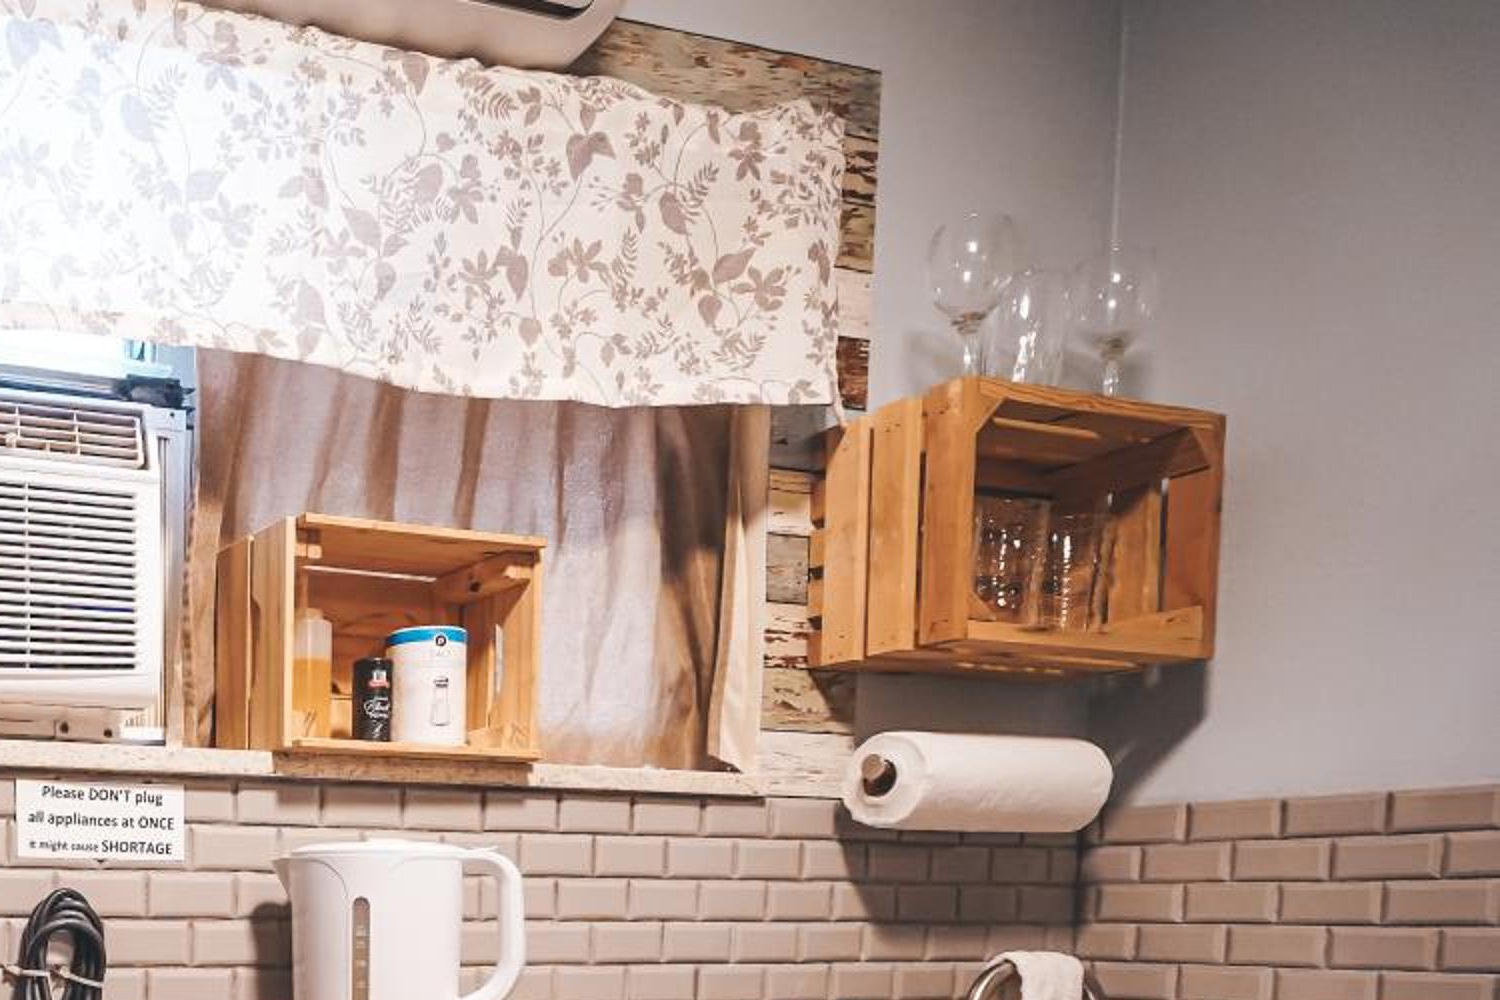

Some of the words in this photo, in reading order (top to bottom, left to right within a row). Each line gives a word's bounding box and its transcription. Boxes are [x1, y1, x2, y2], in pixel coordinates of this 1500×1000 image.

[41, 785, 85, 800] Please
[89, 787, 131, 802] DON'T
[135, 791, 163, 806] plug
[28, 811, 45, 823] all
[47, 812, 118, 828] appliances
[121, 816, 135, 829] at
[138, 817, 174, 830] ONCE
[39, 841, 68, 851] might
[71, 842, 99, 852] cause
[101, 840, 173, 855] SHORTAGE
